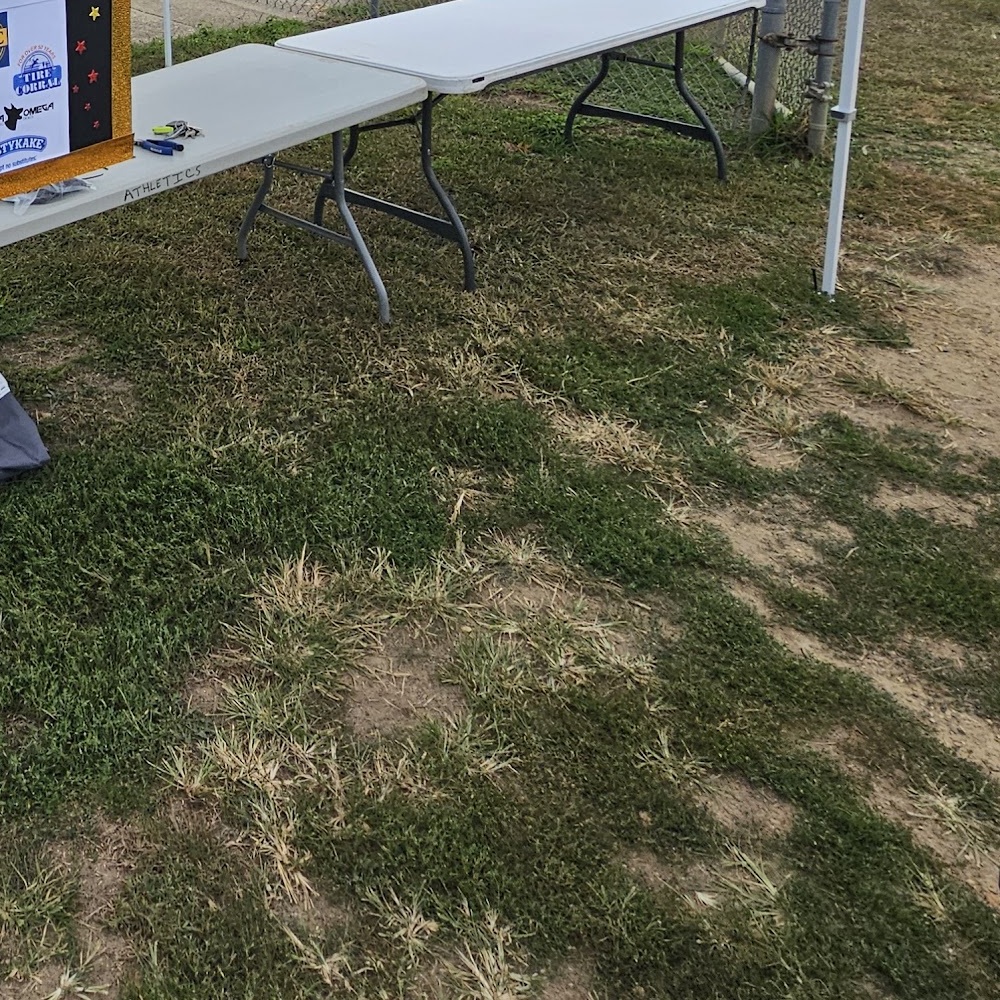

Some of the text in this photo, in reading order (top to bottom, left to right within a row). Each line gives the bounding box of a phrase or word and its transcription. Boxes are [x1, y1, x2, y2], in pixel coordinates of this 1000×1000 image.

[22, 69, 52, 83] TIRE
[15, 77, 61, 96] CORRAL
[23, 102, 54, 117] OMEGA
[123, 164, 201, 201] ATHLETICS
